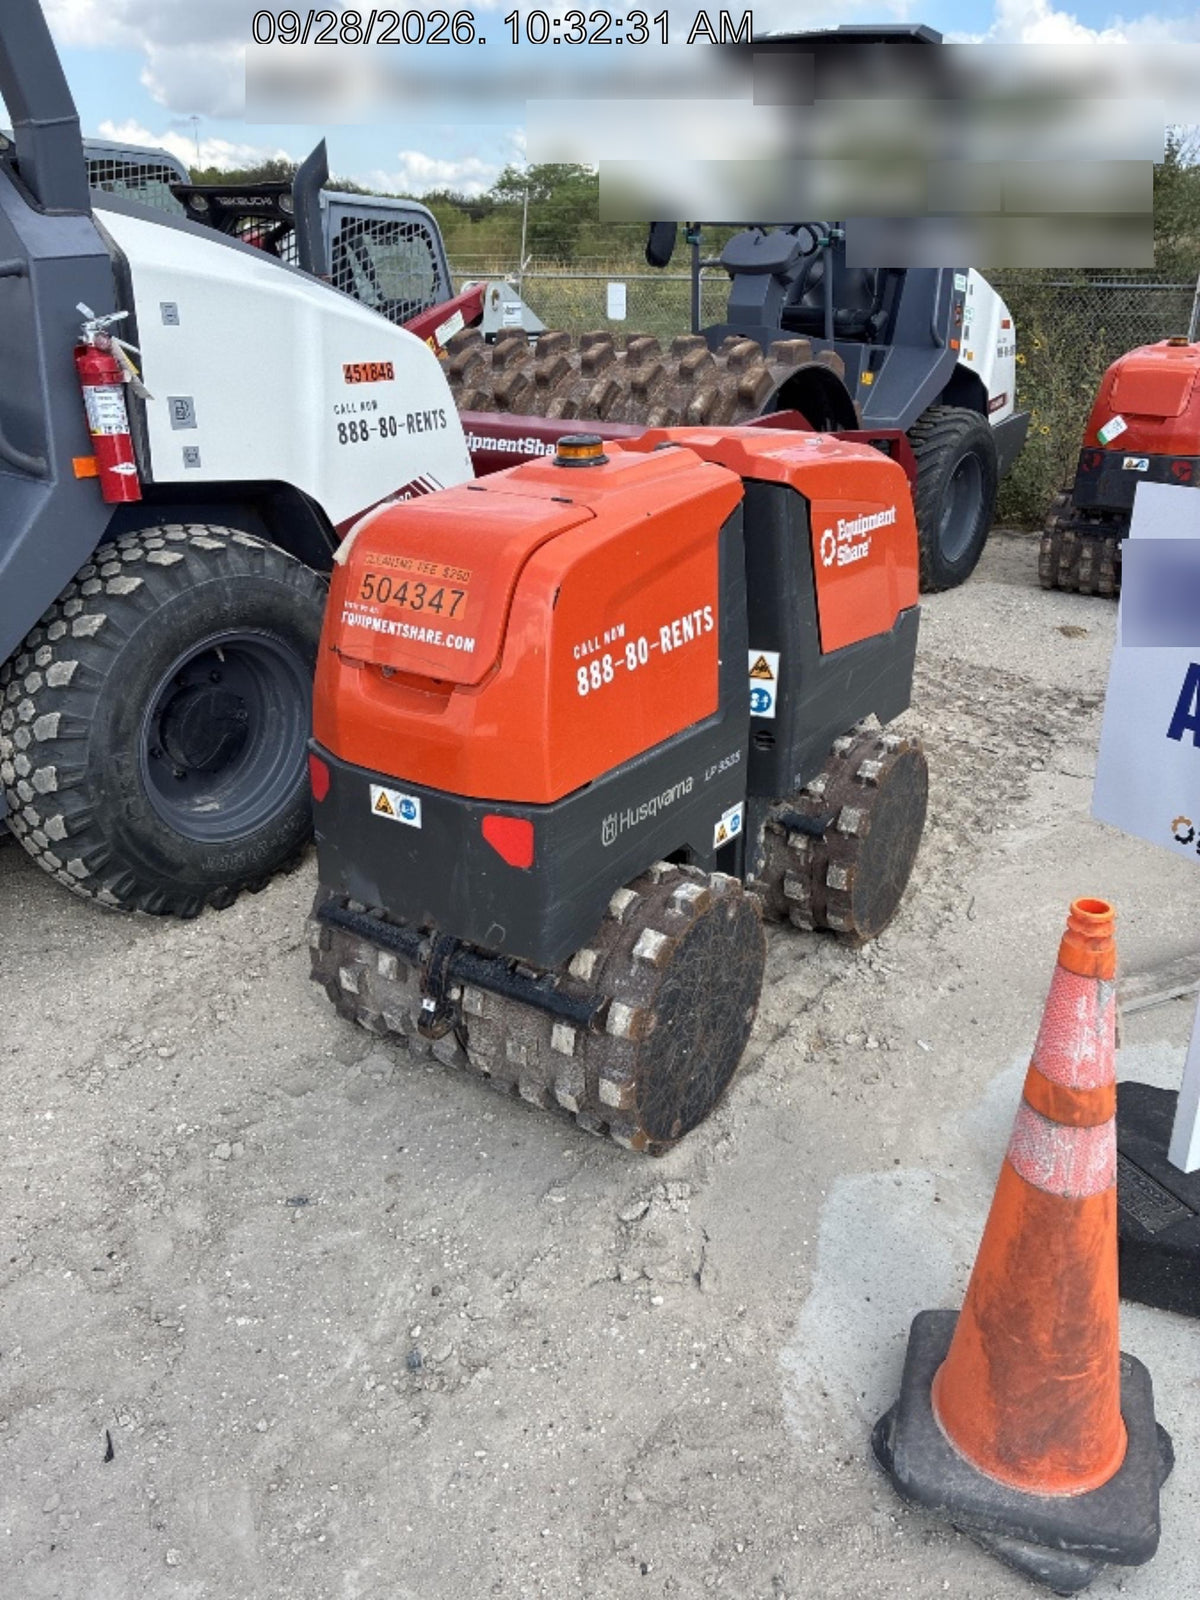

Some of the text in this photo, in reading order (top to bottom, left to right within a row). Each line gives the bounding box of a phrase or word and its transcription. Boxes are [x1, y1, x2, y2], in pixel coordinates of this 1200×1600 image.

[333, 403, 357, 415] CALL
[337, 408, 447, 445] 888-80-RENTS
[837, 505, 896, 542] Equipment
[837, 541, 869, 566] Share
[361, 573, 465, 617] 504347
[573, 622, 626, 660] CALL NOW
[576, 605, 714, 696] 888-80-RENTS
[619, 775, 694, 833] Husqvarna
